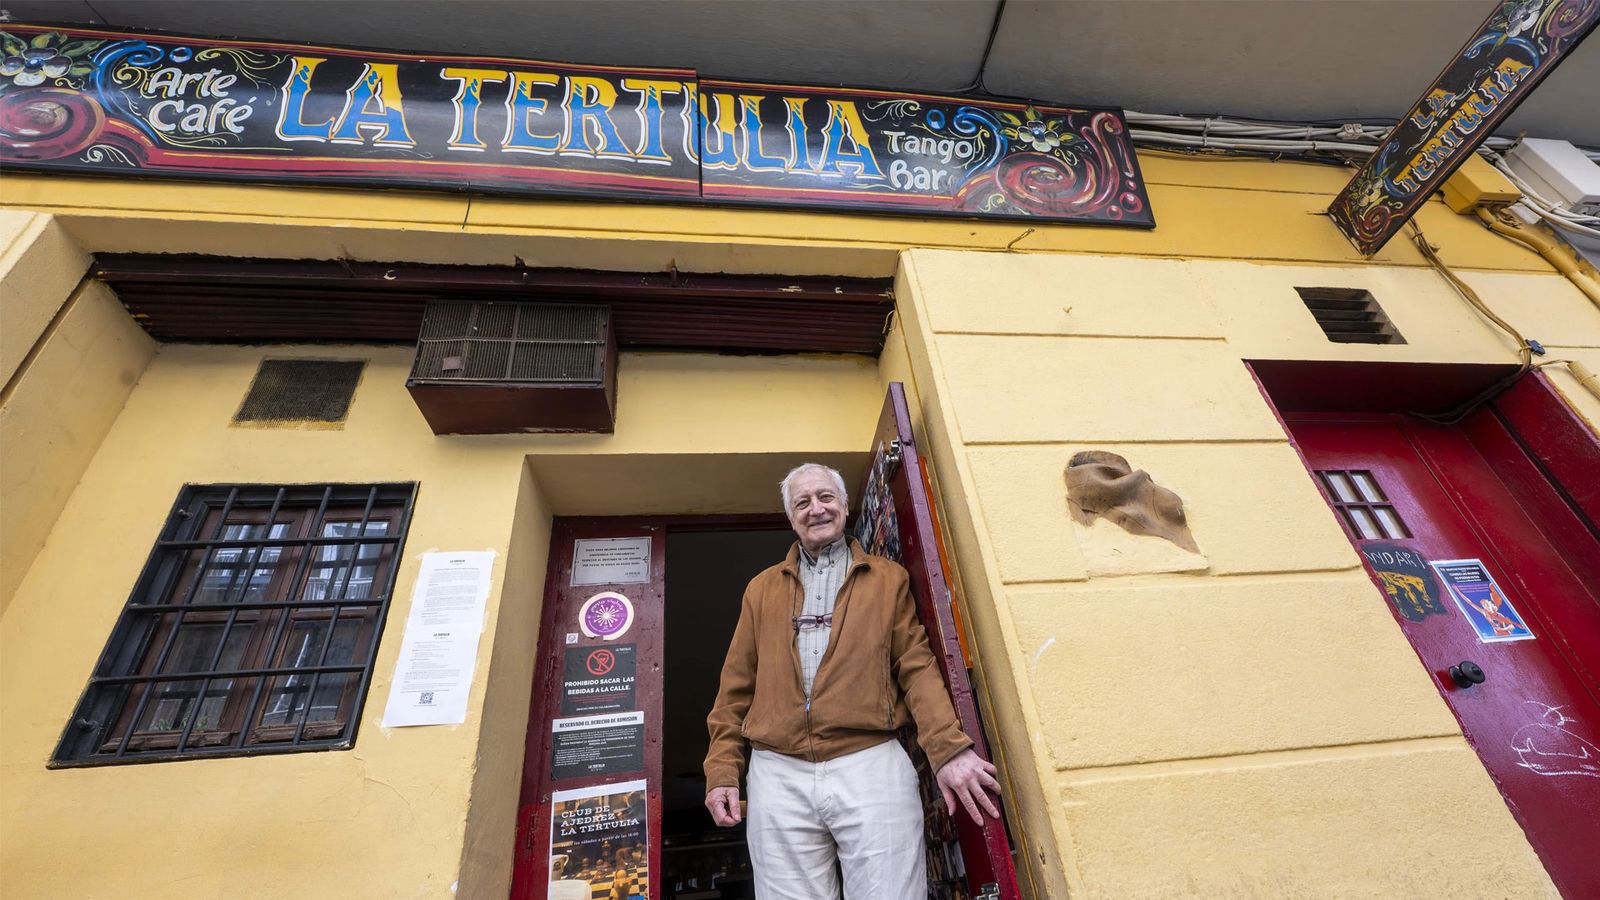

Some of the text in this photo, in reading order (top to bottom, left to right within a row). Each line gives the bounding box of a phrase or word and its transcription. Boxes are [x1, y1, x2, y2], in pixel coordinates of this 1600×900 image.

[147, 64, 230, 99] Arte
[148, 96, 256, 135] Café
[275, 56, 885, 181] LA TERTULIA
[1392, 56, 1535, 194] TERTULIA
[1409, 87, 1457, 130] LA
[883, 129, 975, 164] Tango
[561, 805, 610, 819] CLUB DE
[561, 813, 615, 827] AJEDREZ
[561, 818, 640, 836] LA TERTULIA
